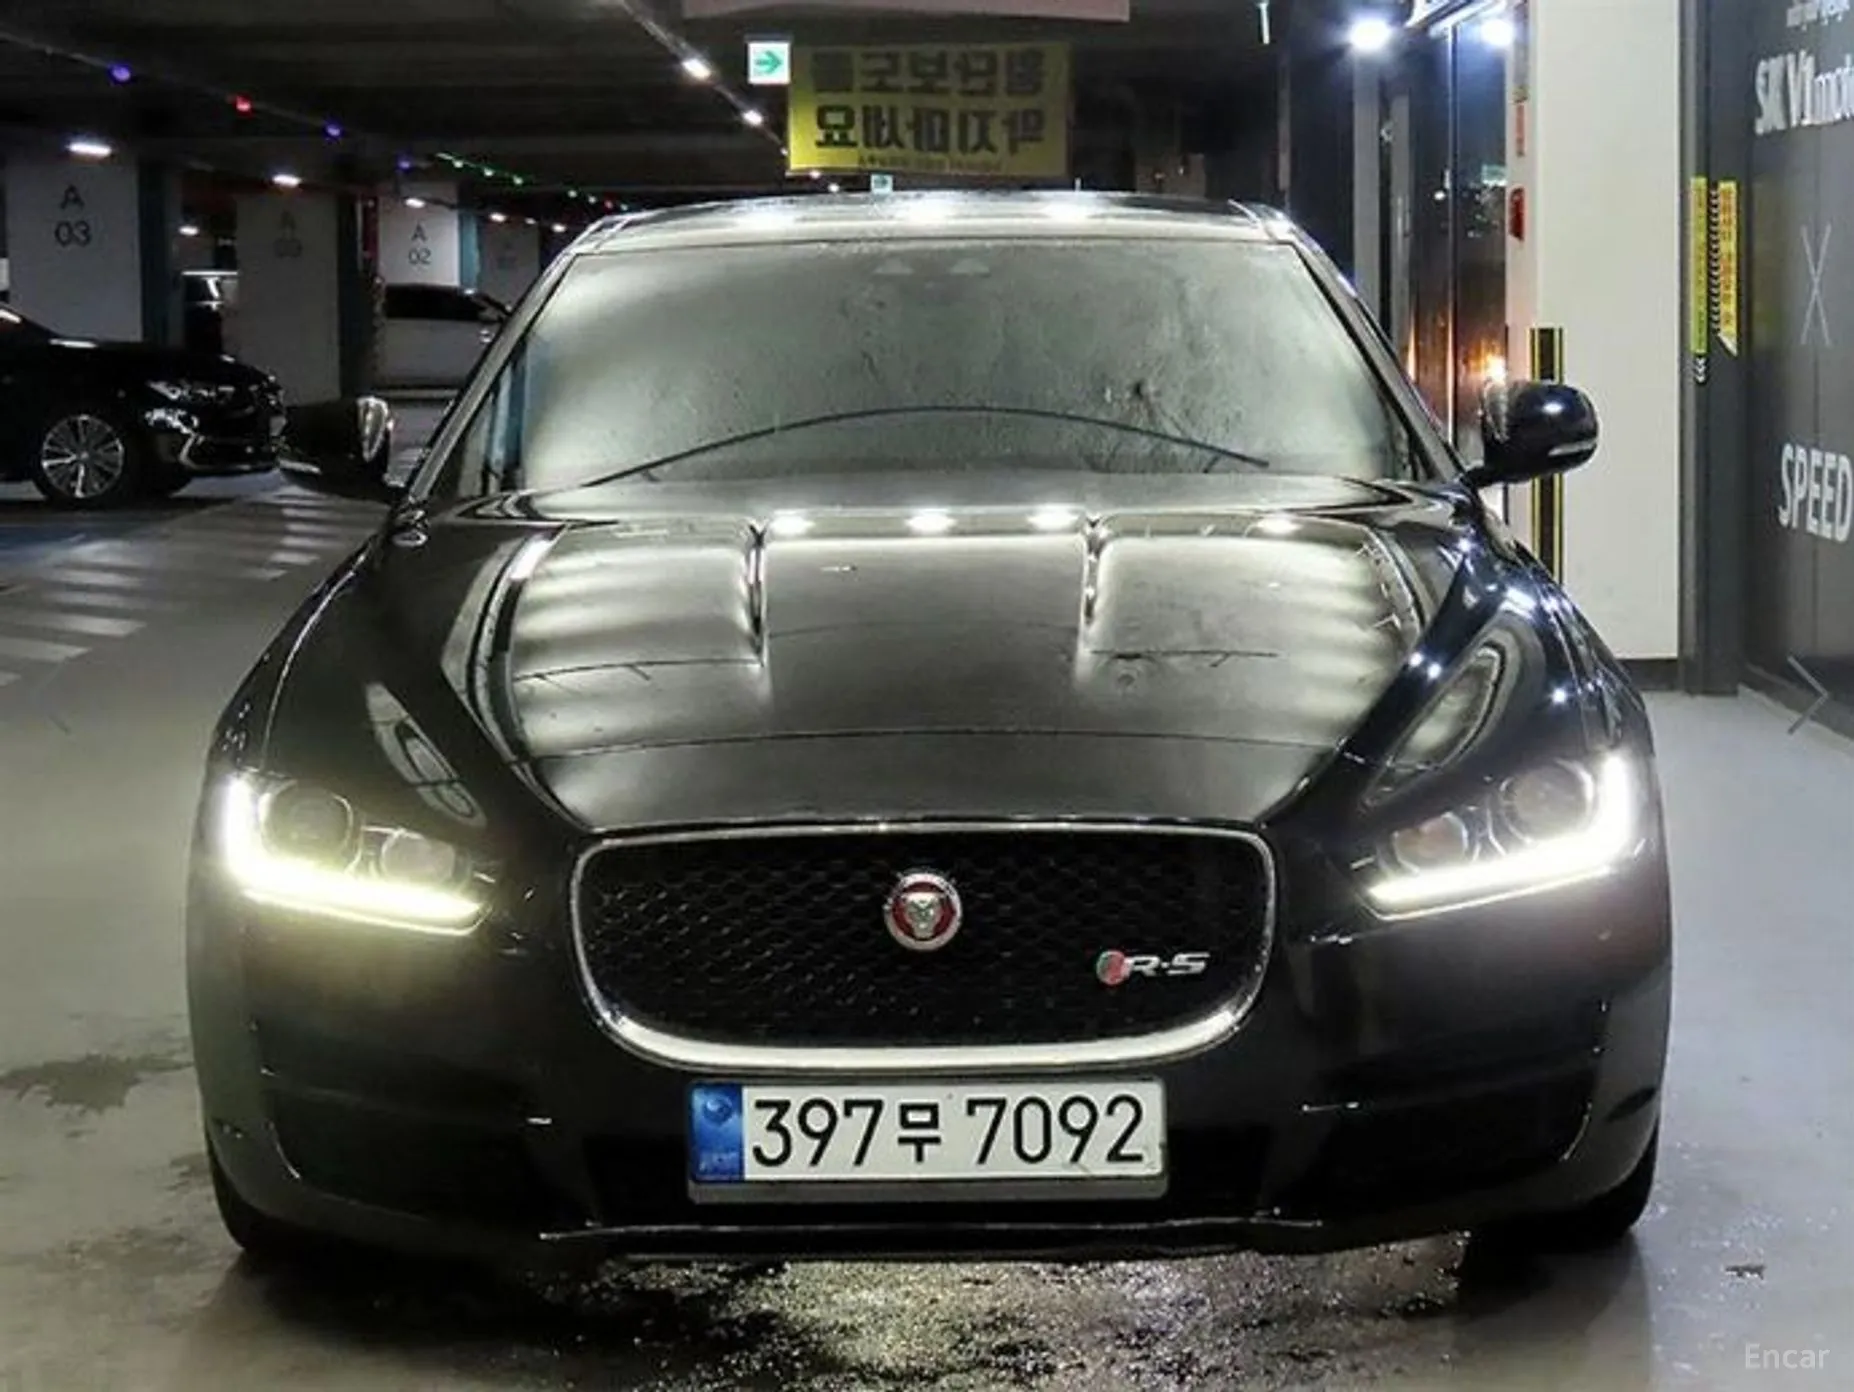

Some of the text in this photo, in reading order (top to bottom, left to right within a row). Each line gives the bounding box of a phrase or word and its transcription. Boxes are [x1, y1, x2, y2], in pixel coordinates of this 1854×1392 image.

[1786, 50, 1854, 128] V1mot
[60, 184, 85, 210] A
[54, 220, 91, 248] 03
[411, 223, 427, 241] A
[408, 248, 431, 265] 02
[1778, 443, 1854, 542] SPEED
[752, 1095, 1145, 1167] 397무 7092
